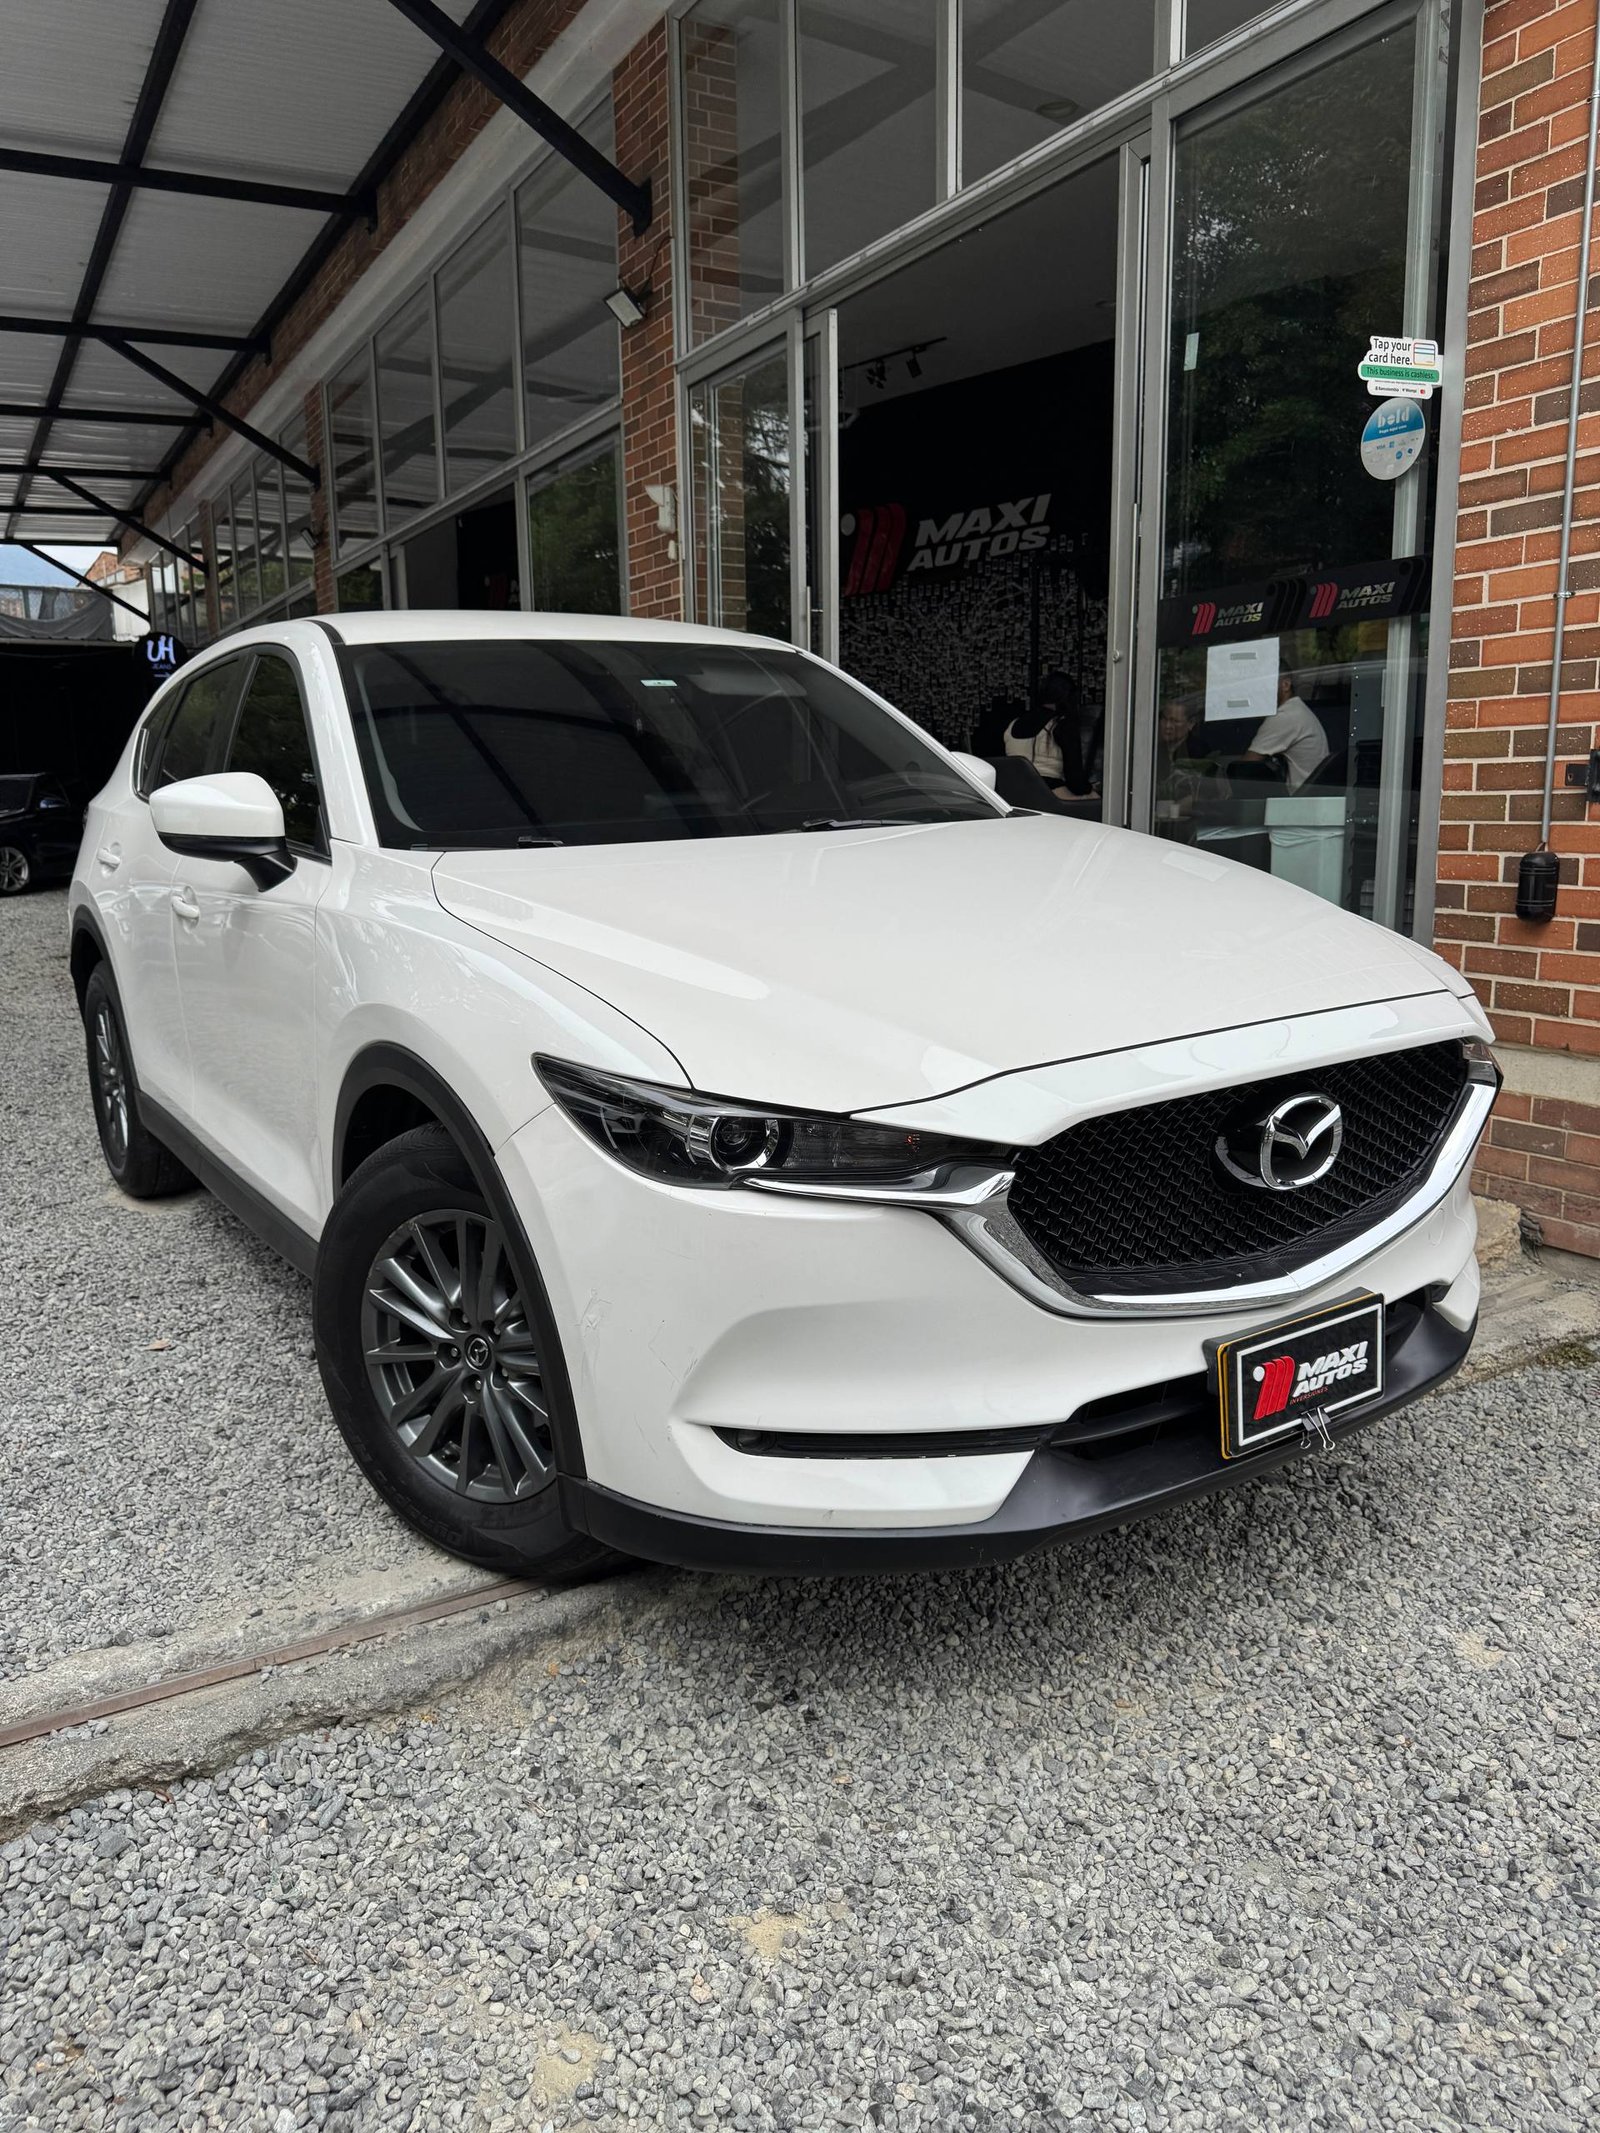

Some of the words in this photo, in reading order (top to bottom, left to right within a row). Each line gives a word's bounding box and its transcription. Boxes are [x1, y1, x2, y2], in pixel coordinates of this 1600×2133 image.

[1373, 338, 1389, 352] Tap
[1391, 342, 1411, 353] your
[1368, 353, 1388, 363] card
[1390, 353, 1413, 365] here.
[1367, 367, 1379, 375] This
[1380, 368, 1404, 377] business
[1378, 406, 1410, 427] bold
[914, 493, 1052, 547] MAXI
[906, 525, 1051, 572] AUTOS
[1339, 581, 1396, 600] MAXI
[1217, 602, 1264, 618] MAXI
[1335, 593, 1394, 610] AUTOS
[1214, 613, 1263, 628] AUTOS
[146, 635, 176, 665] UH
[1296, 1340, 1369, 1381] MAXI
[1292, 1358, 1368, 1398] AUTOS
